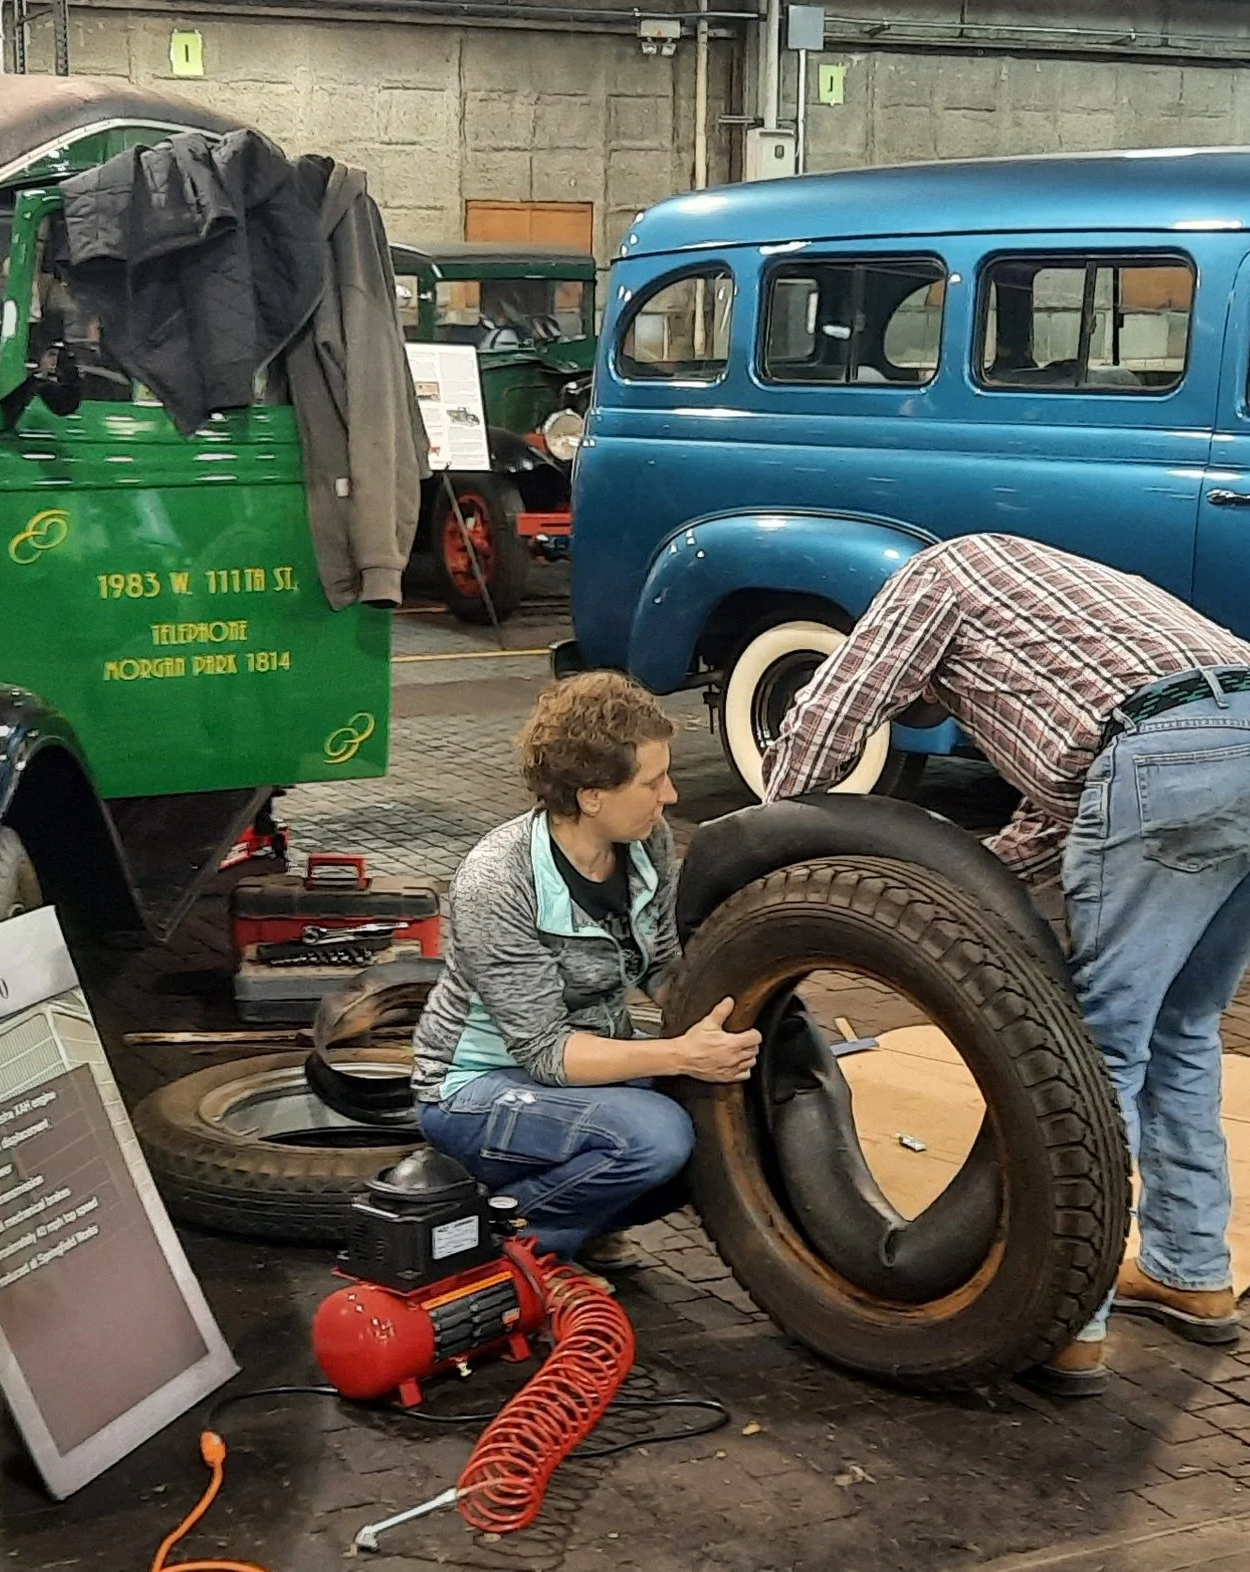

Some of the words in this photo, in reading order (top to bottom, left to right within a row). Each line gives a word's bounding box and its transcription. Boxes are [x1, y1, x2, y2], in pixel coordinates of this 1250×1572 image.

[96, 571, 161, 600] 1983
[150, 619, 248, 646] TELEPHONE
[103, 656, 186, 682] MORGAN
[192, 652, 238, 677] PARK
[246, 650, 291, 673] 1814
